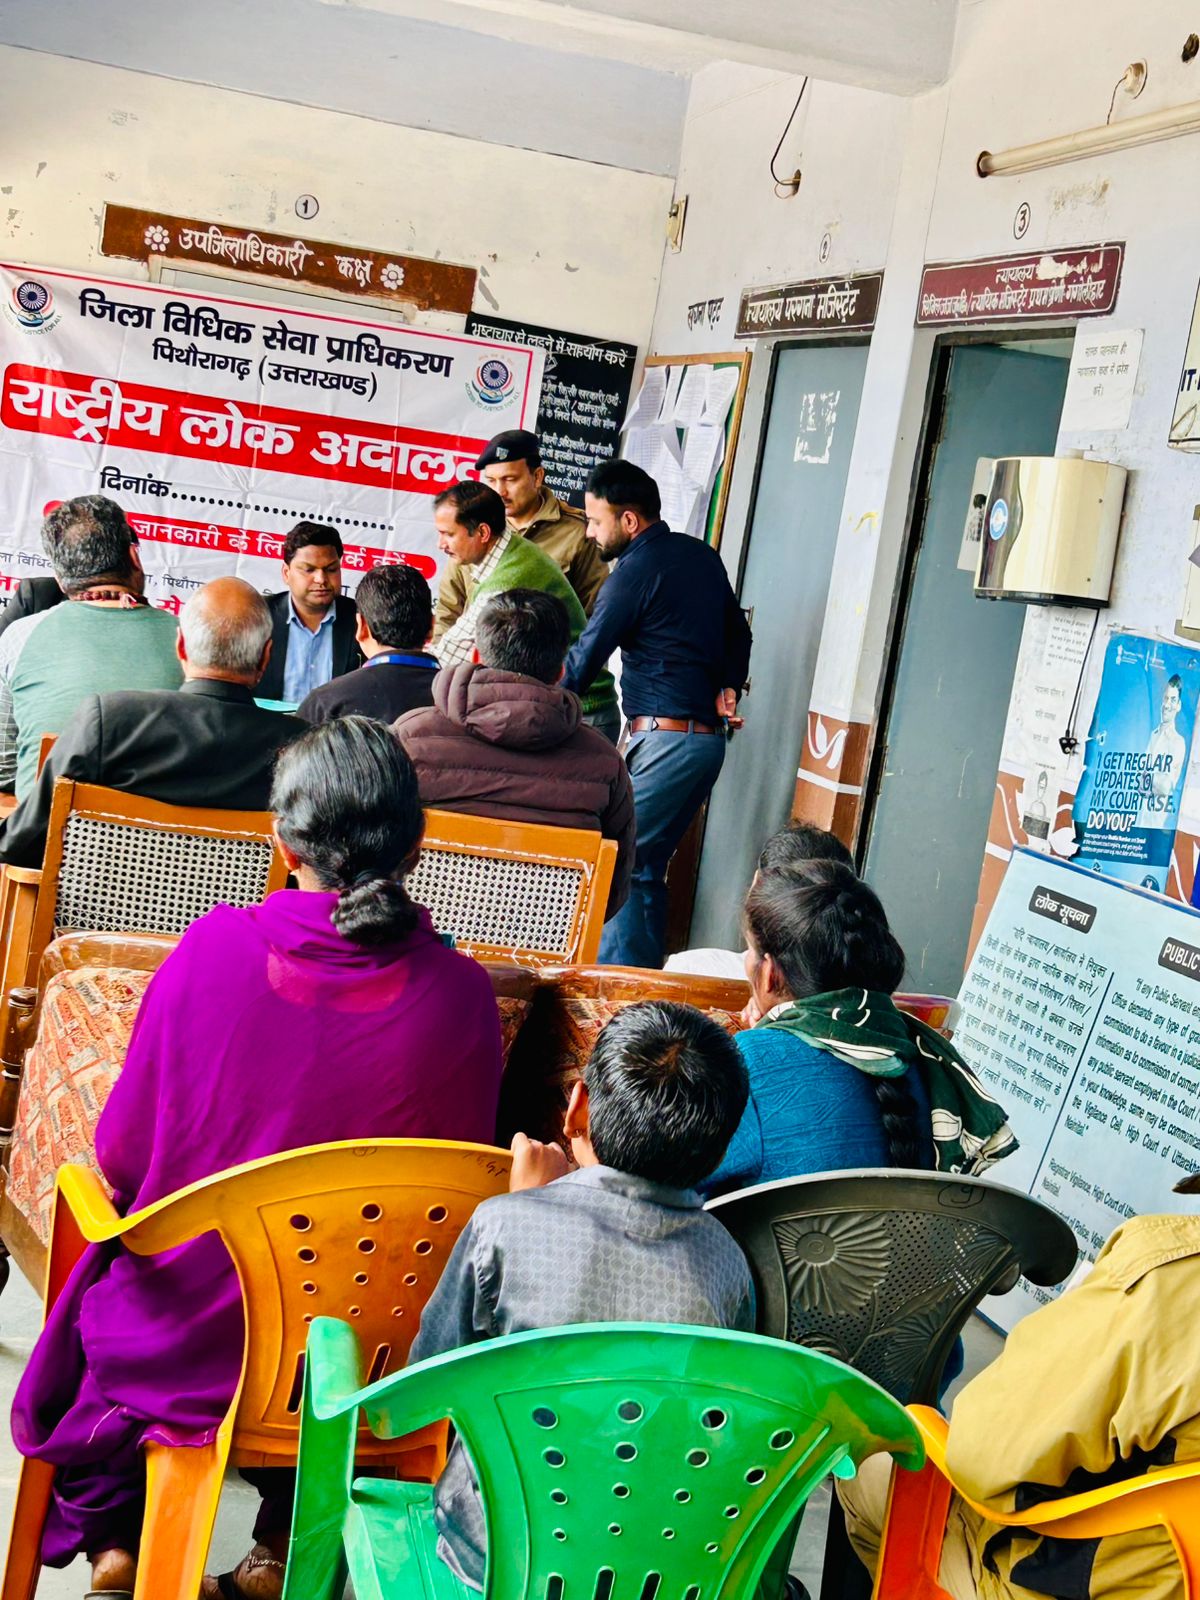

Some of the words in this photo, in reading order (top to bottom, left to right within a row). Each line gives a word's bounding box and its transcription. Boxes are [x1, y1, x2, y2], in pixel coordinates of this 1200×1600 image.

[178, 226, 315, 276] उपजिलाधिकारी
[335, 254, 374, 288] कक्ष
[78, 287, 156, 330] जिला
[162, 301, 256, 345] विधिक
[263, 319, 319, 356] सेवा
[326, 332, 455, 378] प्राधिकरण
[566, 343, 603, 363] सहयोग
[604, 349, 628, 368] करें
[152, 337, 252, 382] पिथौरागढ़
[258, 355, 378, 402] (उत्तराखण्ड)
[9, 379, 169, 443] राष्ट्रीय
[179, 401, 301, 455] लोक
[228, 529, 250, 551] के
[256, 535, 285, 556] लि
[1103, 751, 1125, 770] GET
[1094, 770, 1141, 792] UPDATES
[1109, 791, 1147, 811] COURT
[1087, 810, 1105, 830] DO
[1034, 893, 1060, 913] लोक
[1059, 902, 1091, 926] सूचना
